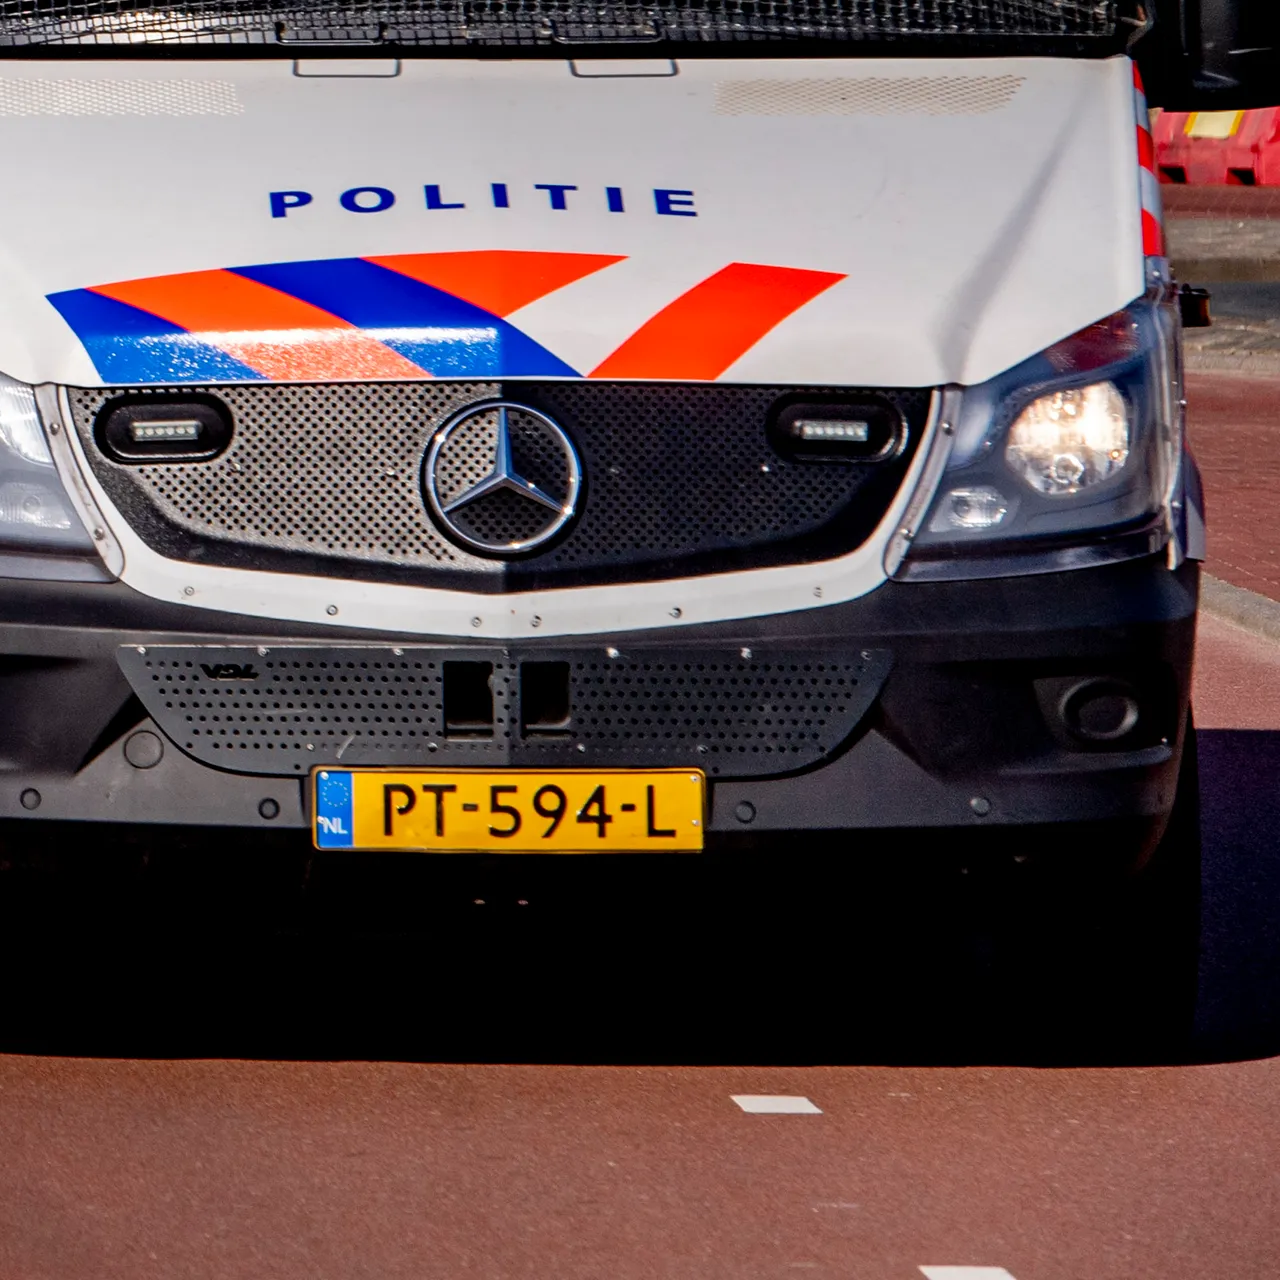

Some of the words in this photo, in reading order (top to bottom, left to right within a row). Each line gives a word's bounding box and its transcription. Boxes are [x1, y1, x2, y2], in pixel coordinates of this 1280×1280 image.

[269, 183, 699, 218] POLITIE
[322, 817, 348, 835] NL
[383, 783, 677, 839] PT-594-L
